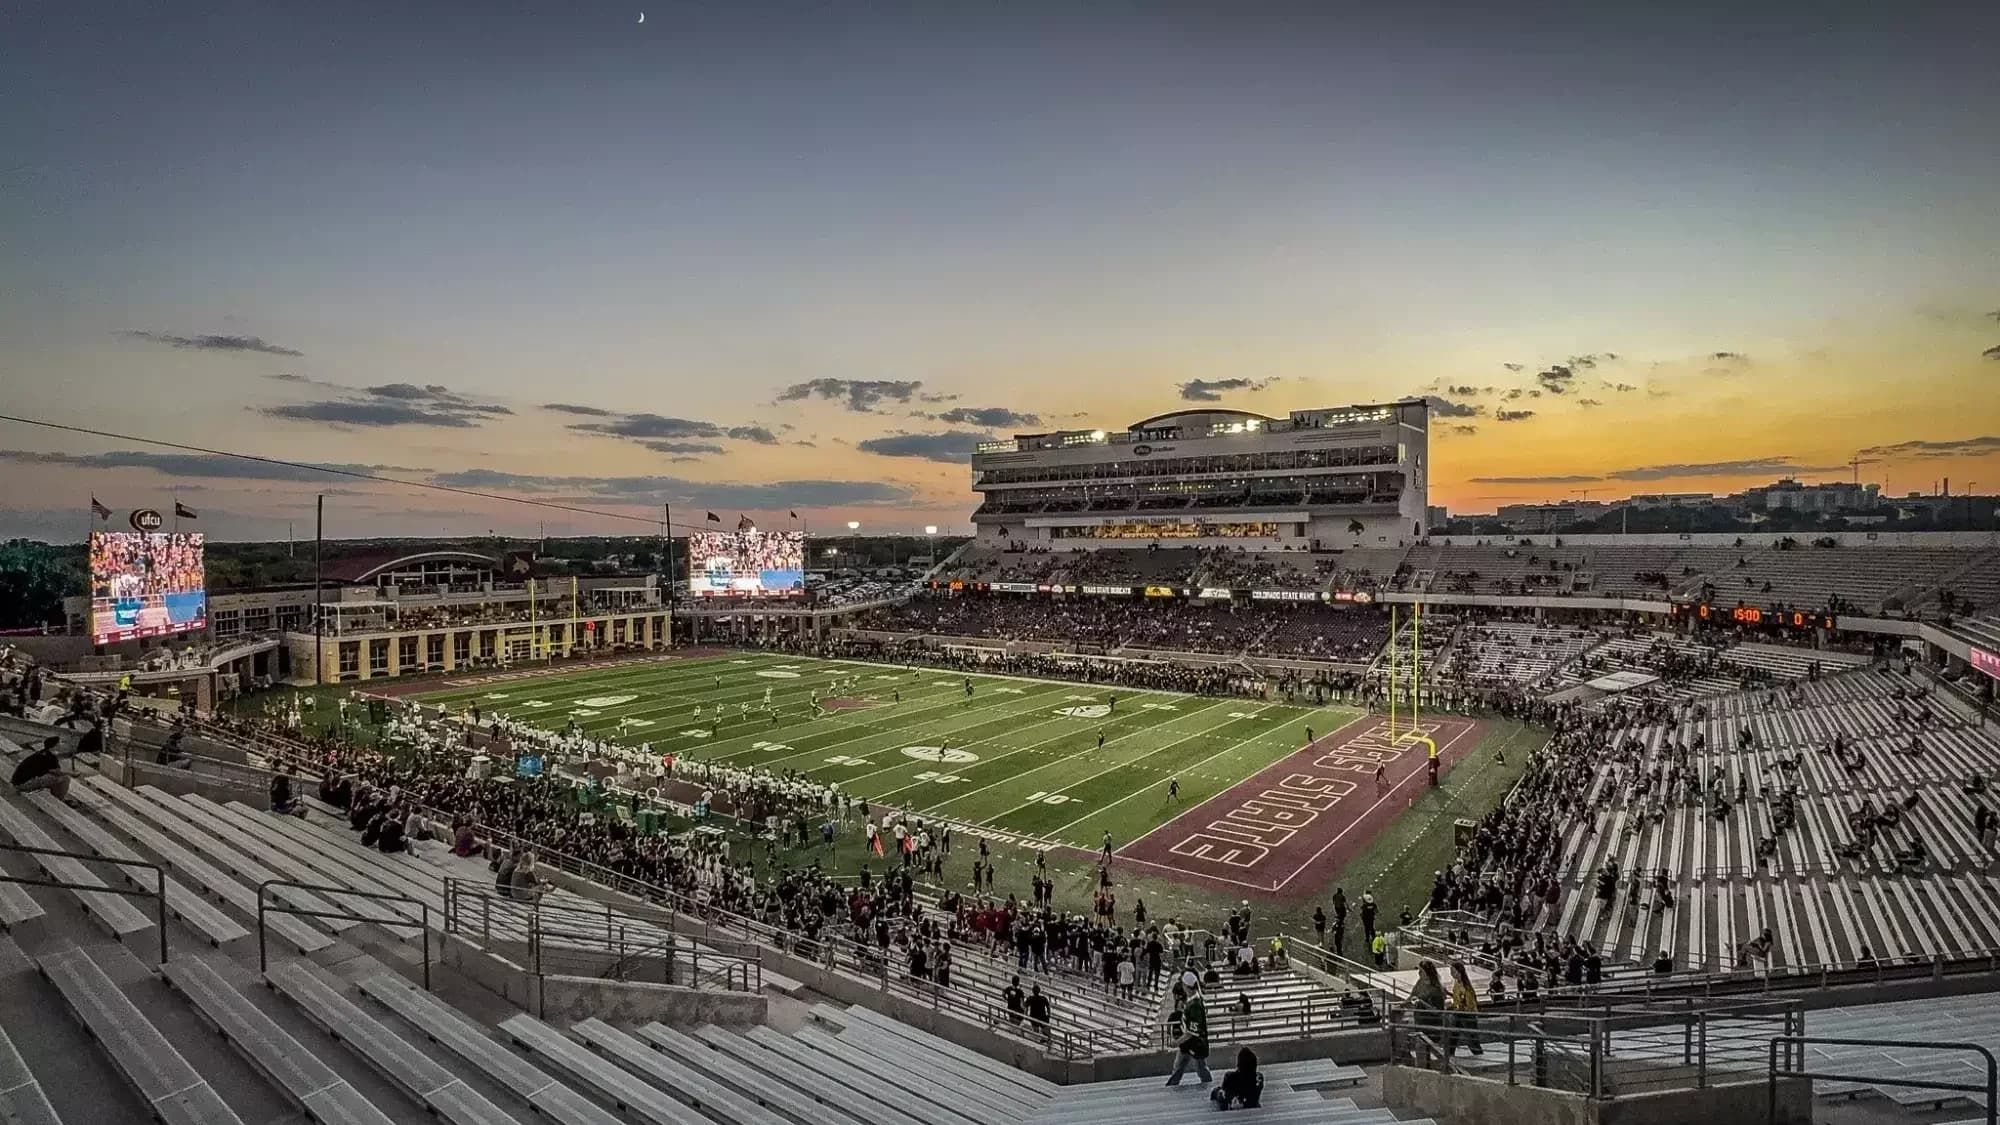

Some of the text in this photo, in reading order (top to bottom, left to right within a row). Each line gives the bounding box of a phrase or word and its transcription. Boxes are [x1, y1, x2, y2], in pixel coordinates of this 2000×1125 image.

[141, 513, 161, 526] ufcu
[1097, 586, 1109, 594] STATE
[1110, 587, 1131, 595] BOBCATS
[1252, 591, 1280, 600] COLORADO
[1281, 591, 1299, 600] STATE
[1300, 591, 1315, 600] RAMS
[1700, 605, 1707, 617] 0
[1734, 608, 1760, 622] 15:00
[1794, 612, 1802, 625] 0
[913, 771, 960, 784] 20
[1025, 791, 1070, 805] 10
[1169, 721, 1441, 867] TEXAS STATE
